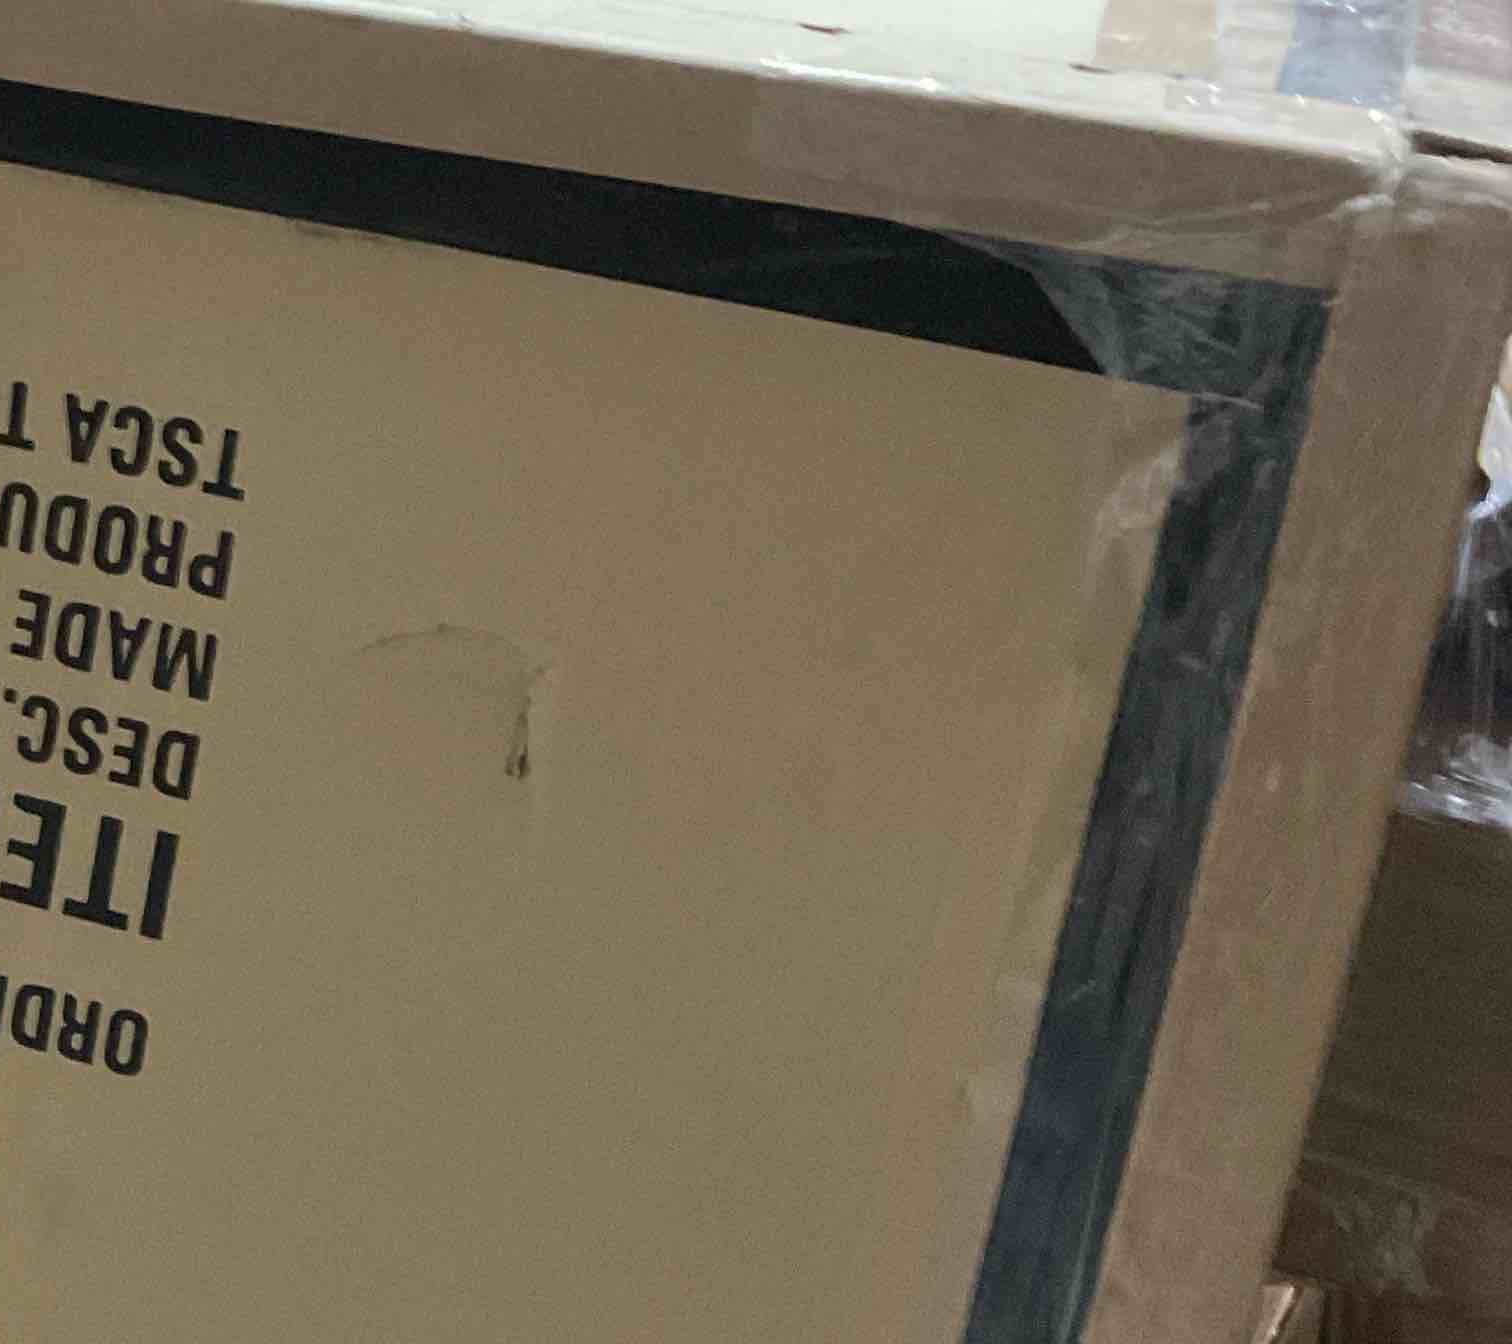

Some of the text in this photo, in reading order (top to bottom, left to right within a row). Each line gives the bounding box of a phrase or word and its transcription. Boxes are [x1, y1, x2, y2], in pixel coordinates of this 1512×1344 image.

[65, 393, 245, 500] TSCA
[10, 589, 216, 701] MADE
[3, 688, 201, 801] DESC.
